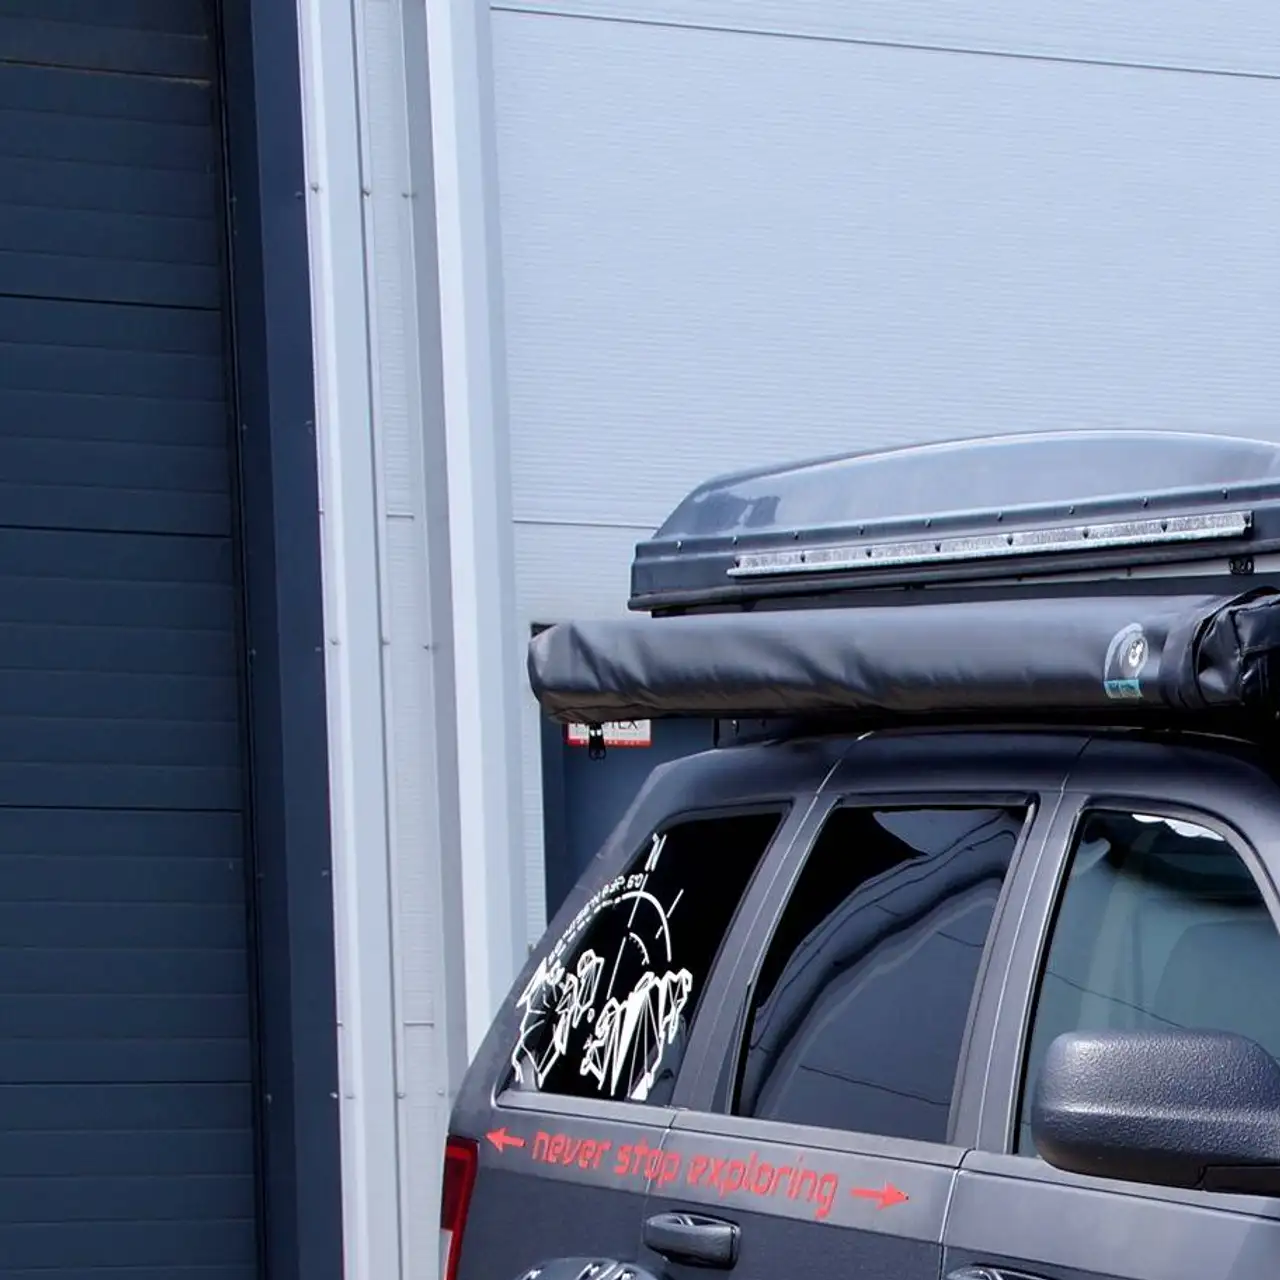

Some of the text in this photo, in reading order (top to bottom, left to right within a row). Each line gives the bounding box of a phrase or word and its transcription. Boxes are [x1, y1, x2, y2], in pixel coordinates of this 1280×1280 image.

[531, 1129, 839, 1221] never stop exploring
